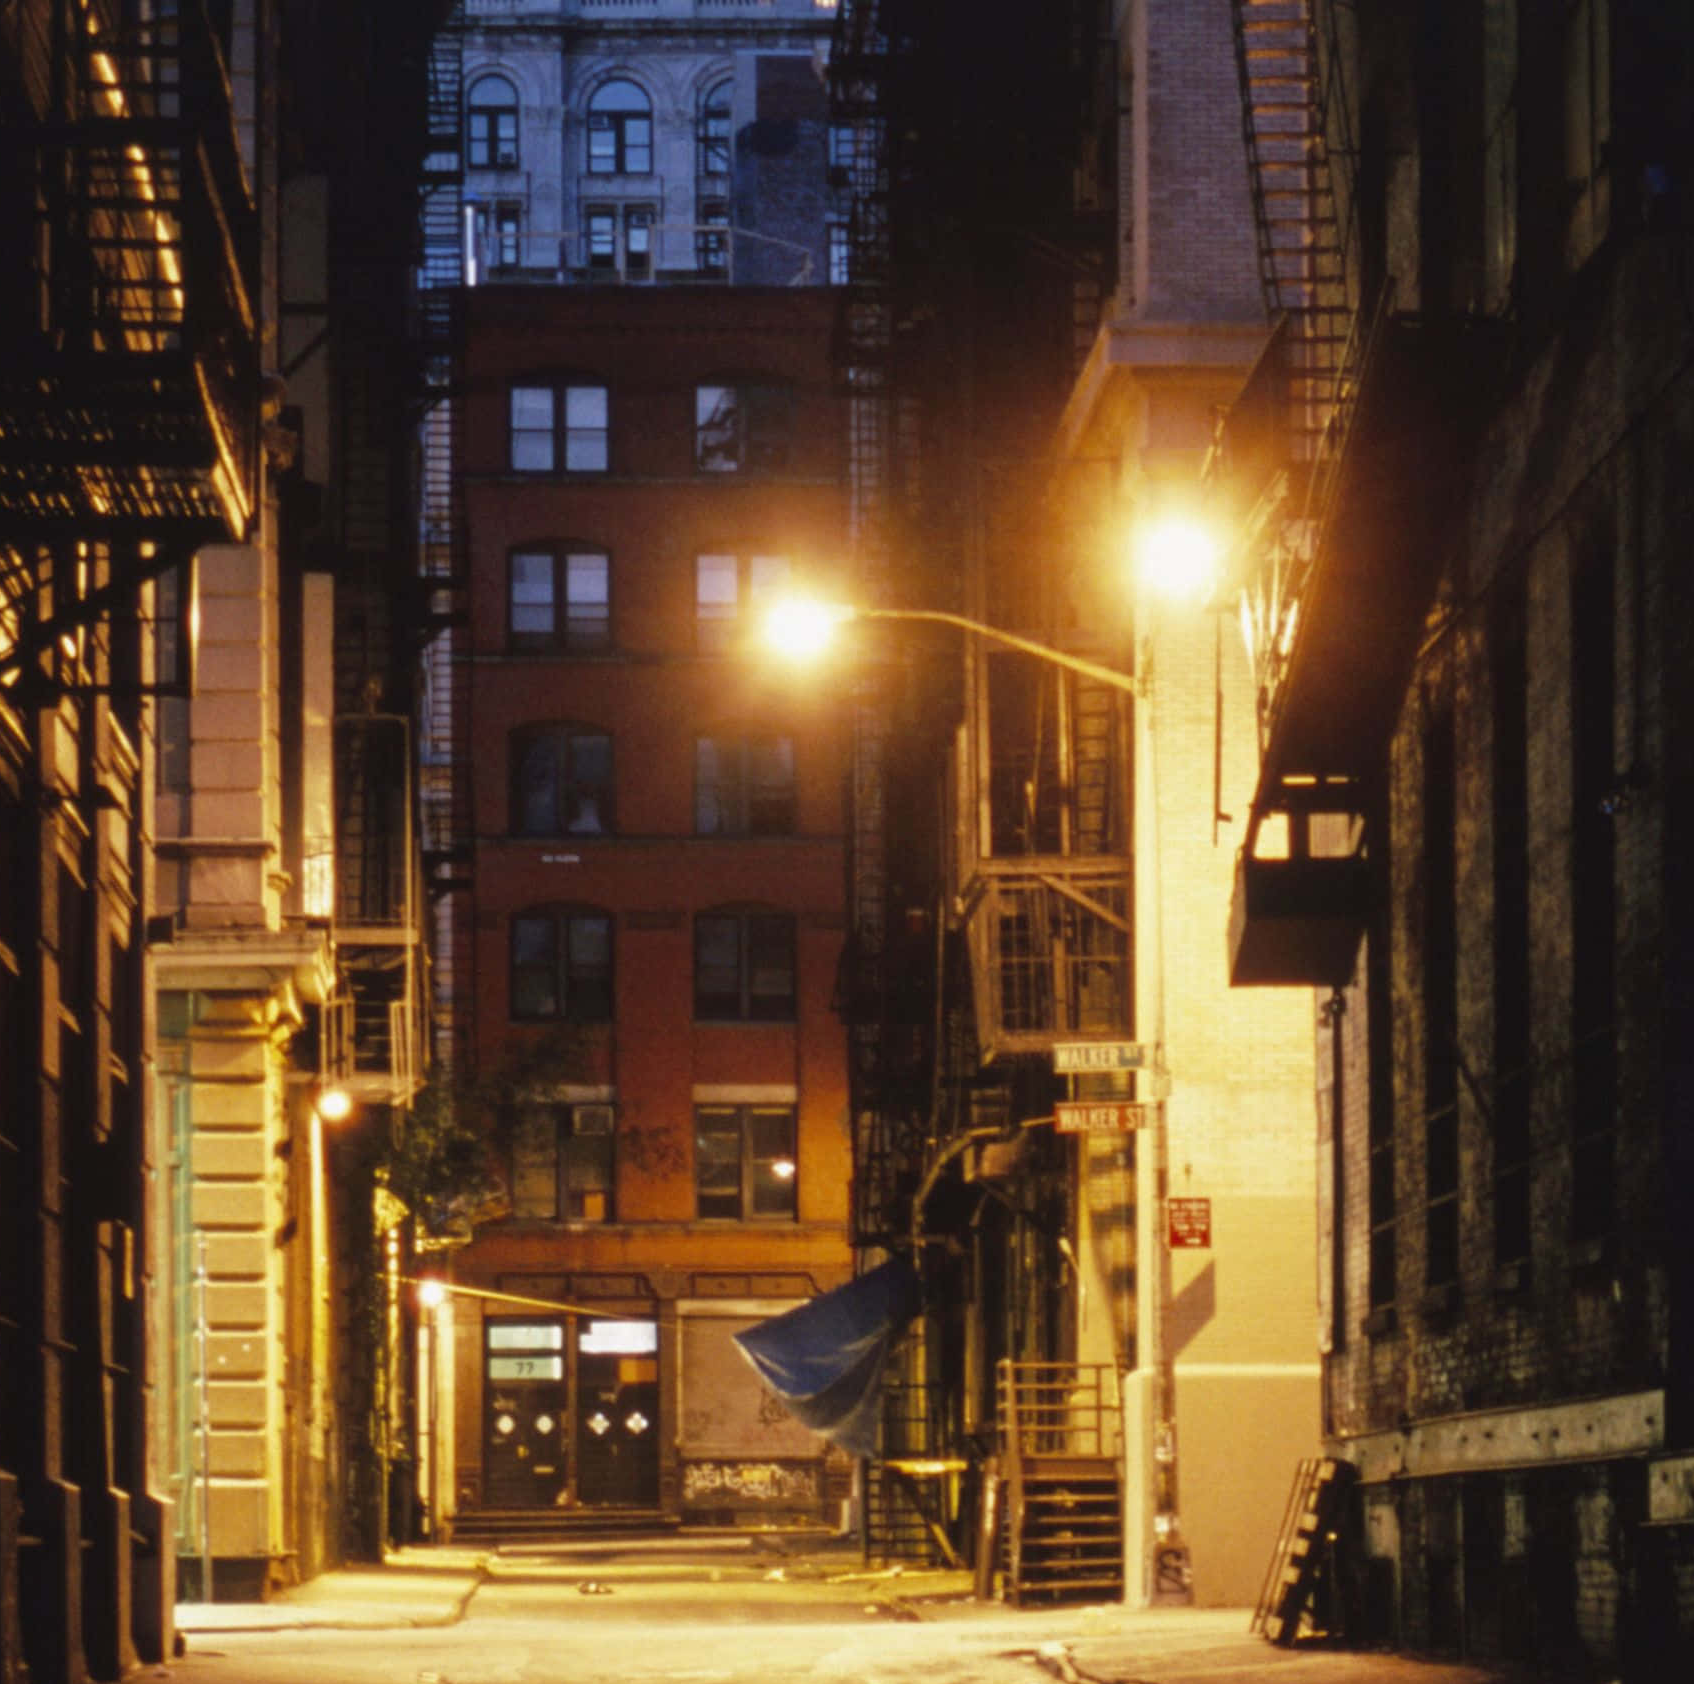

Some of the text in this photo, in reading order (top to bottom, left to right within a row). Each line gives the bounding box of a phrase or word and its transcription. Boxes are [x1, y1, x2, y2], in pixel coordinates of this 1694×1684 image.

[1057, 1047, 1119, 1069] WALKER
[1059, 1107, 1144, 1130] WALKER ST
